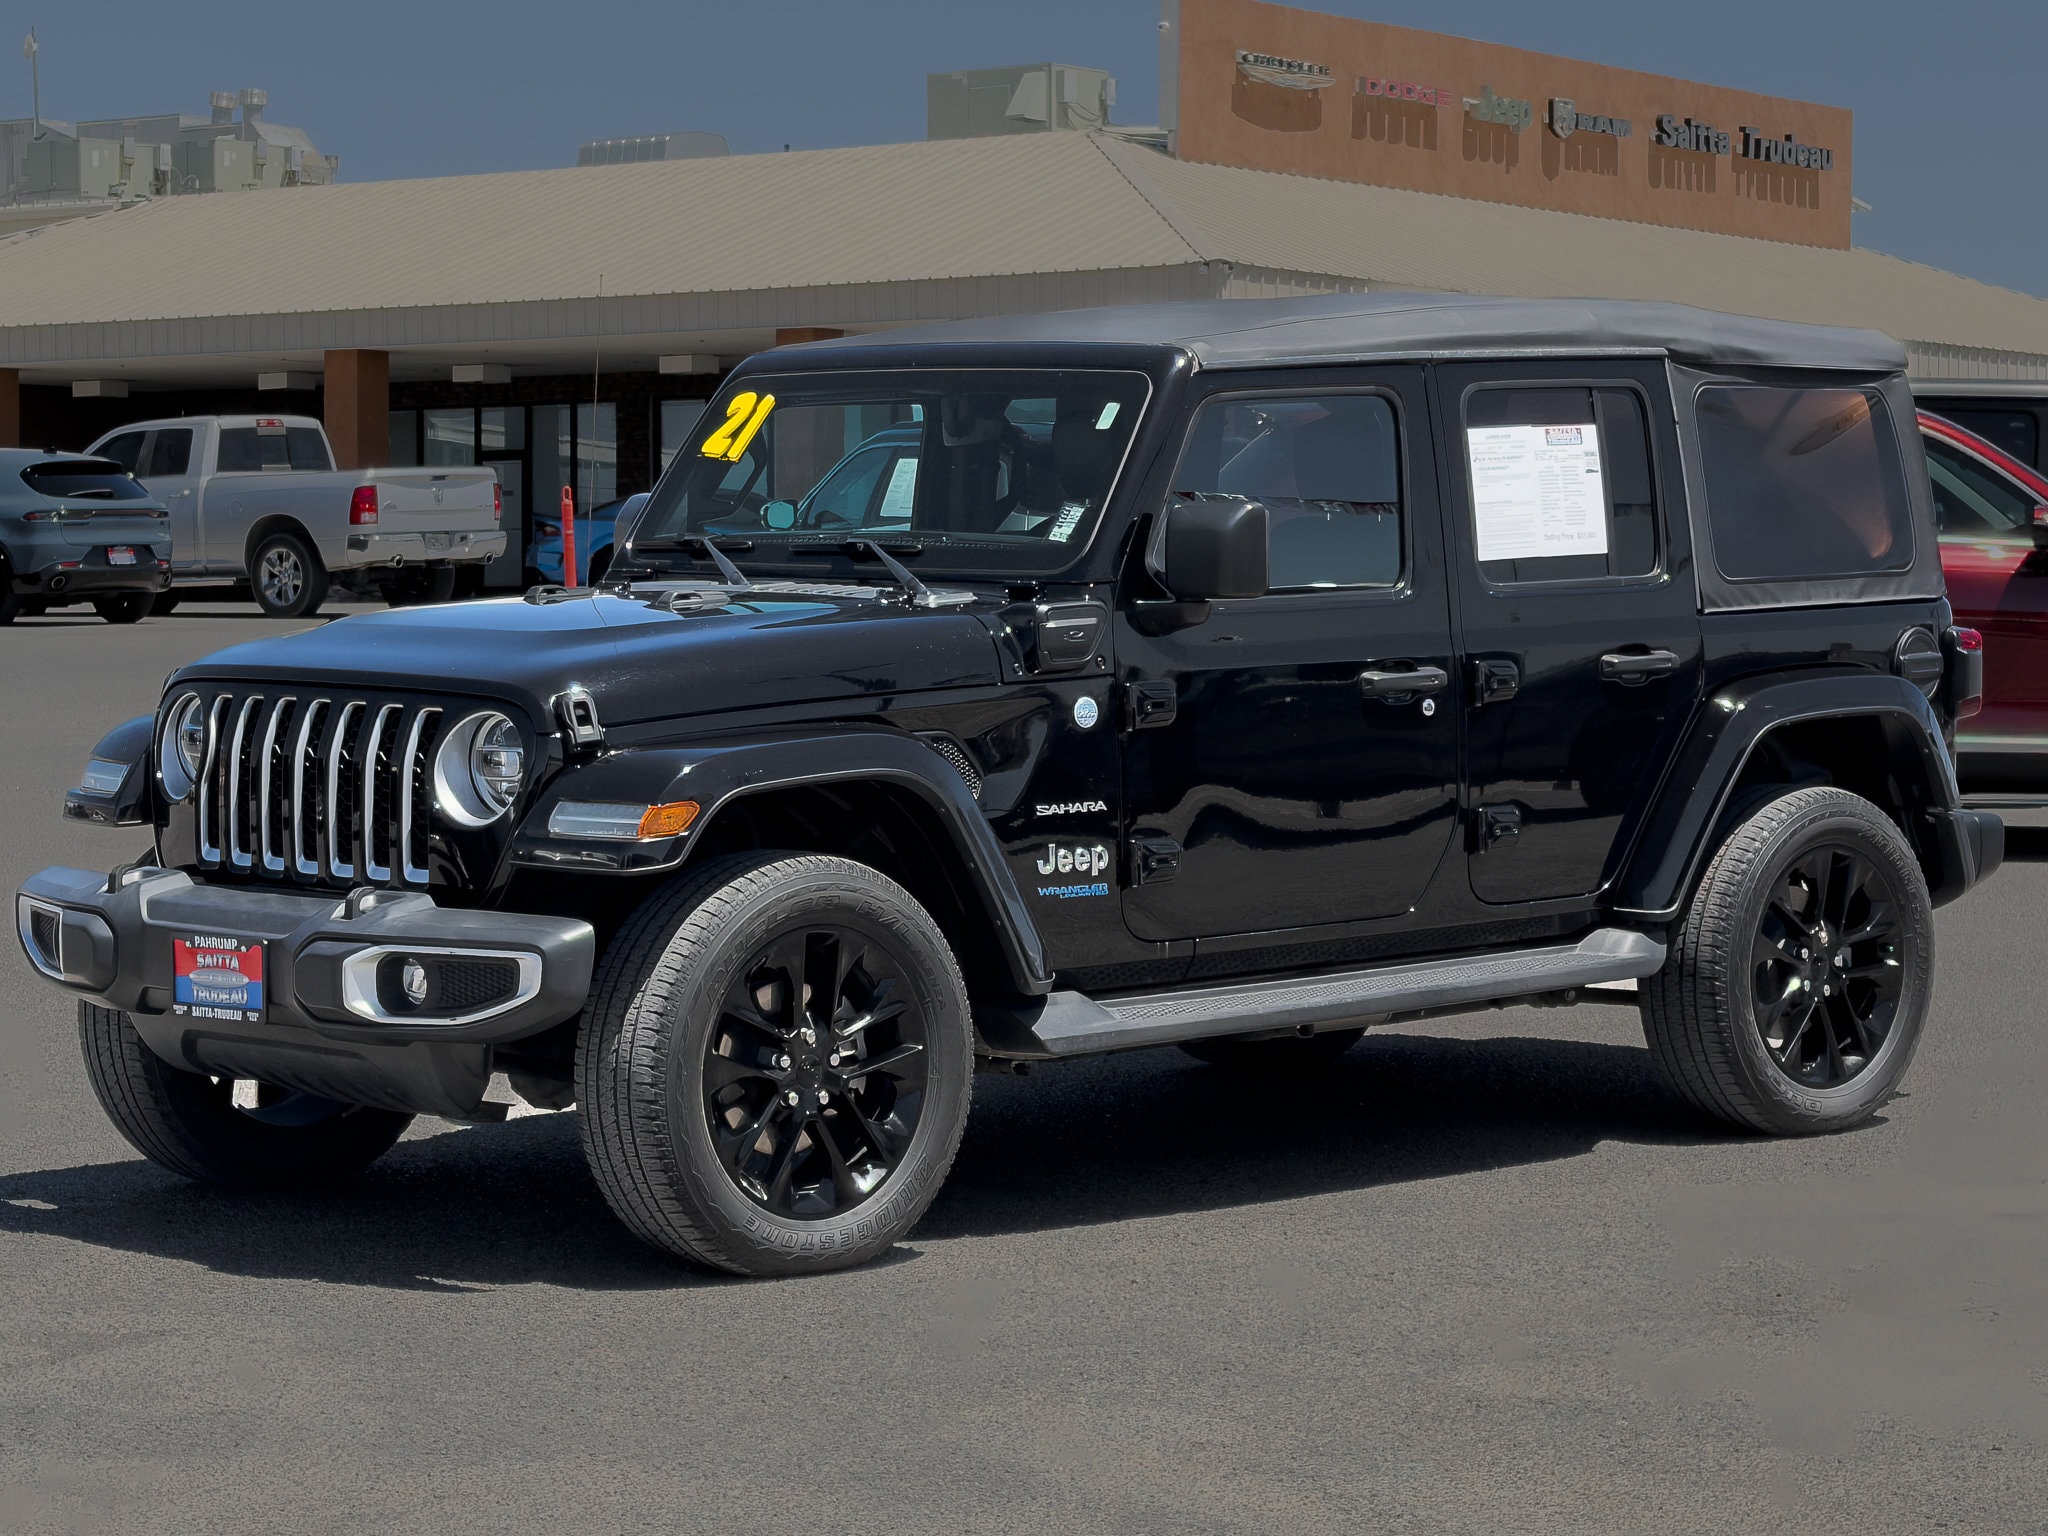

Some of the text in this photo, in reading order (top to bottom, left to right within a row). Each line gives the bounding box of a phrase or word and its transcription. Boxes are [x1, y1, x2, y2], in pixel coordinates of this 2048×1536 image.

[1364, 76, 1452, 106] DODGE
[1466, 85, 1534, 135] Jeep
[1577, 112, 1632, 137] RAM
[1656, 114, 1834, 171] Saitta Trudeau
[701, 391, 776, 463] 21
[1036, 801, 1108, 815] SAHARA
[1036, 843, 1109, 876] Jeep
[194, 935, 238, 950] PAHRUMP
[196, 952, 239, 970] SAITTA
[192, 983, 248, 1004] TRUDEAU
[743, 1156, 934, 1250] BRIDGESTONE
